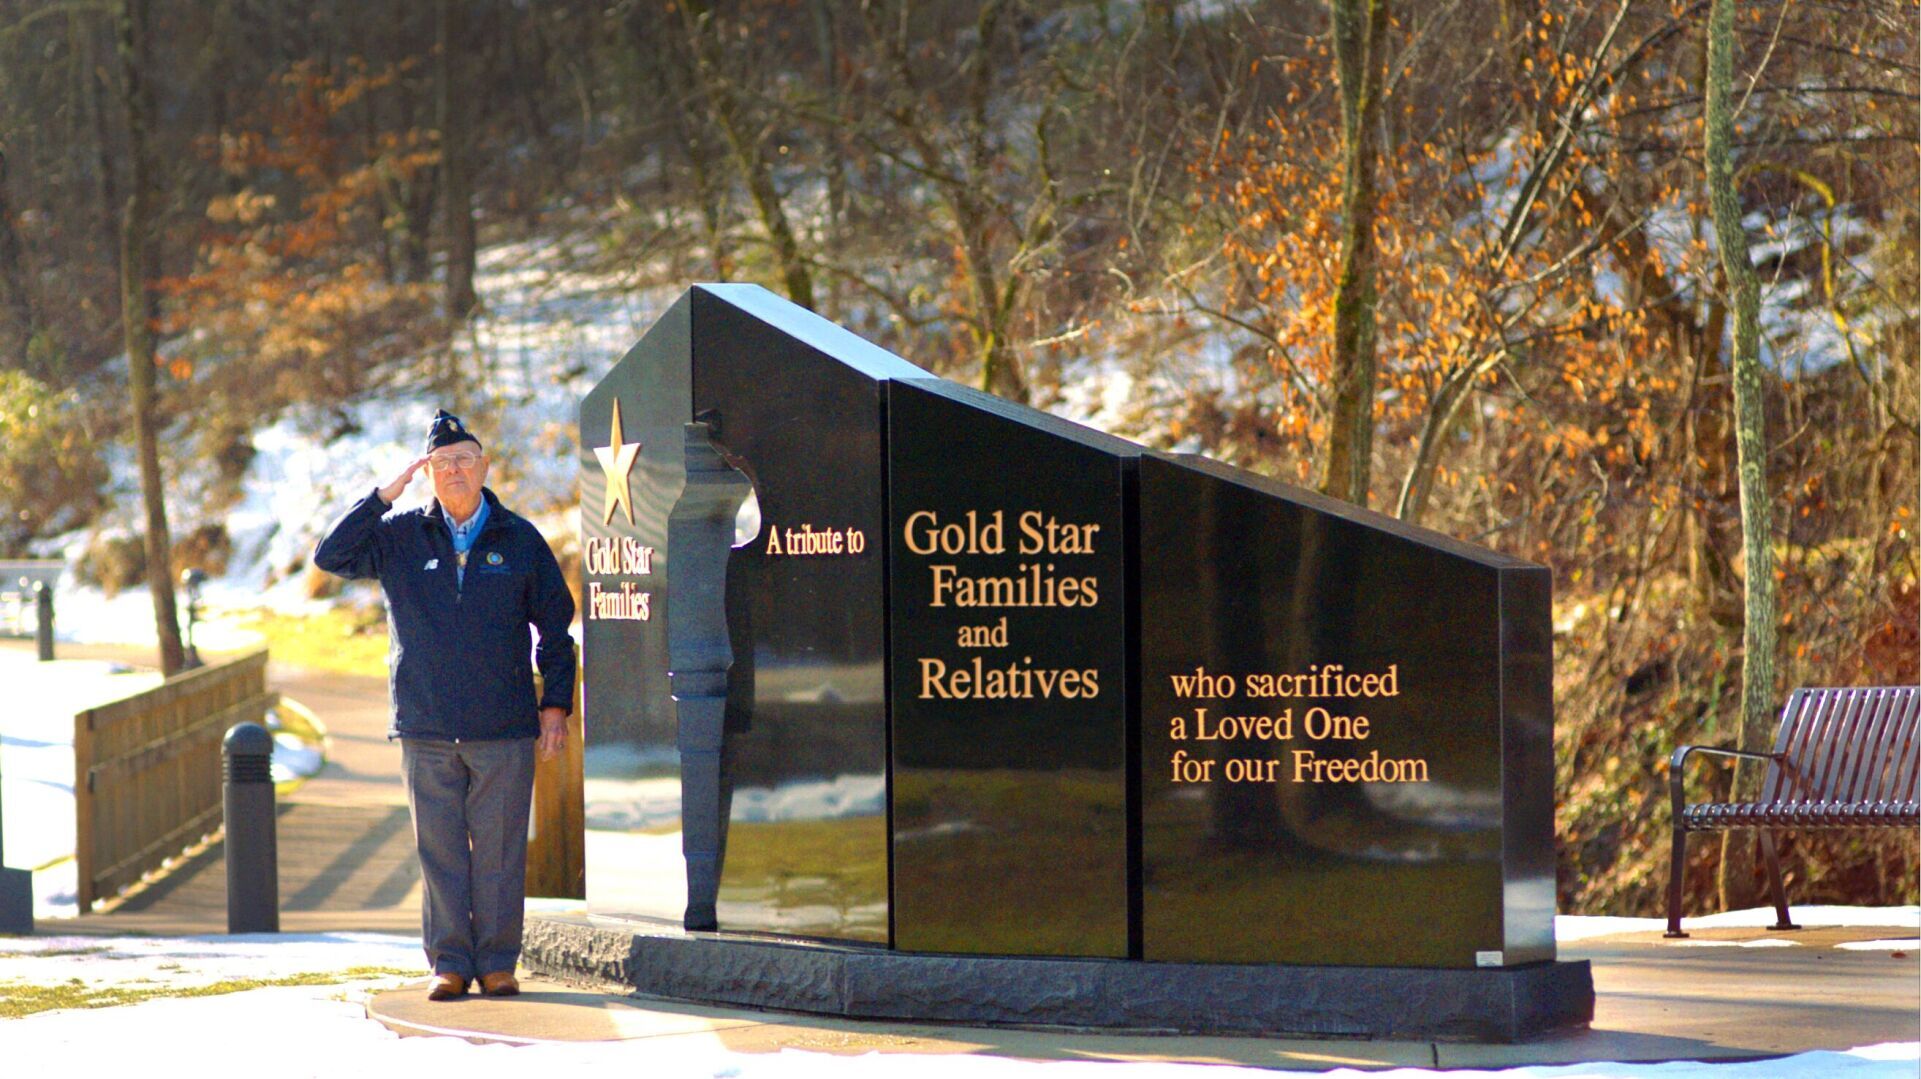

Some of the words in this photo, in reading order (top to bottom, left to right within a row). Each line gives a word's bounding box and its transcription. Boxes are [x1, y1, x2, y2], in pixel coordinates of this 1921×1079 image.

[766, 525, 782, 555] A
[786, 524, 843, 555] tribute
[847, 527, 865, 553] to
[904, 510, 1006, 555] Gold
[1019, 511, 1100, 554] Star
[585, 537, 620, 575] Gold
[622, 537, 653, 575] Star
[589, 582, 649, 621] Families
[929, 563, 1099, 607] Families
[957, 616, 1009, 647] and
[918, 656, 1099, 699] Relatives
[1170, 666, 1236, 698] who
[1246, 664, 1400, 697] sacrificed
[1170, 716, 1187, 740] a
[1195, 708, 1294, 740] Loved
[1304, 707, 1370, 740] One
[1171, 750, 1215, 782] for
[1225, 759, 1280, 782] our
[1291, 750, 1430, 782] Freedom
